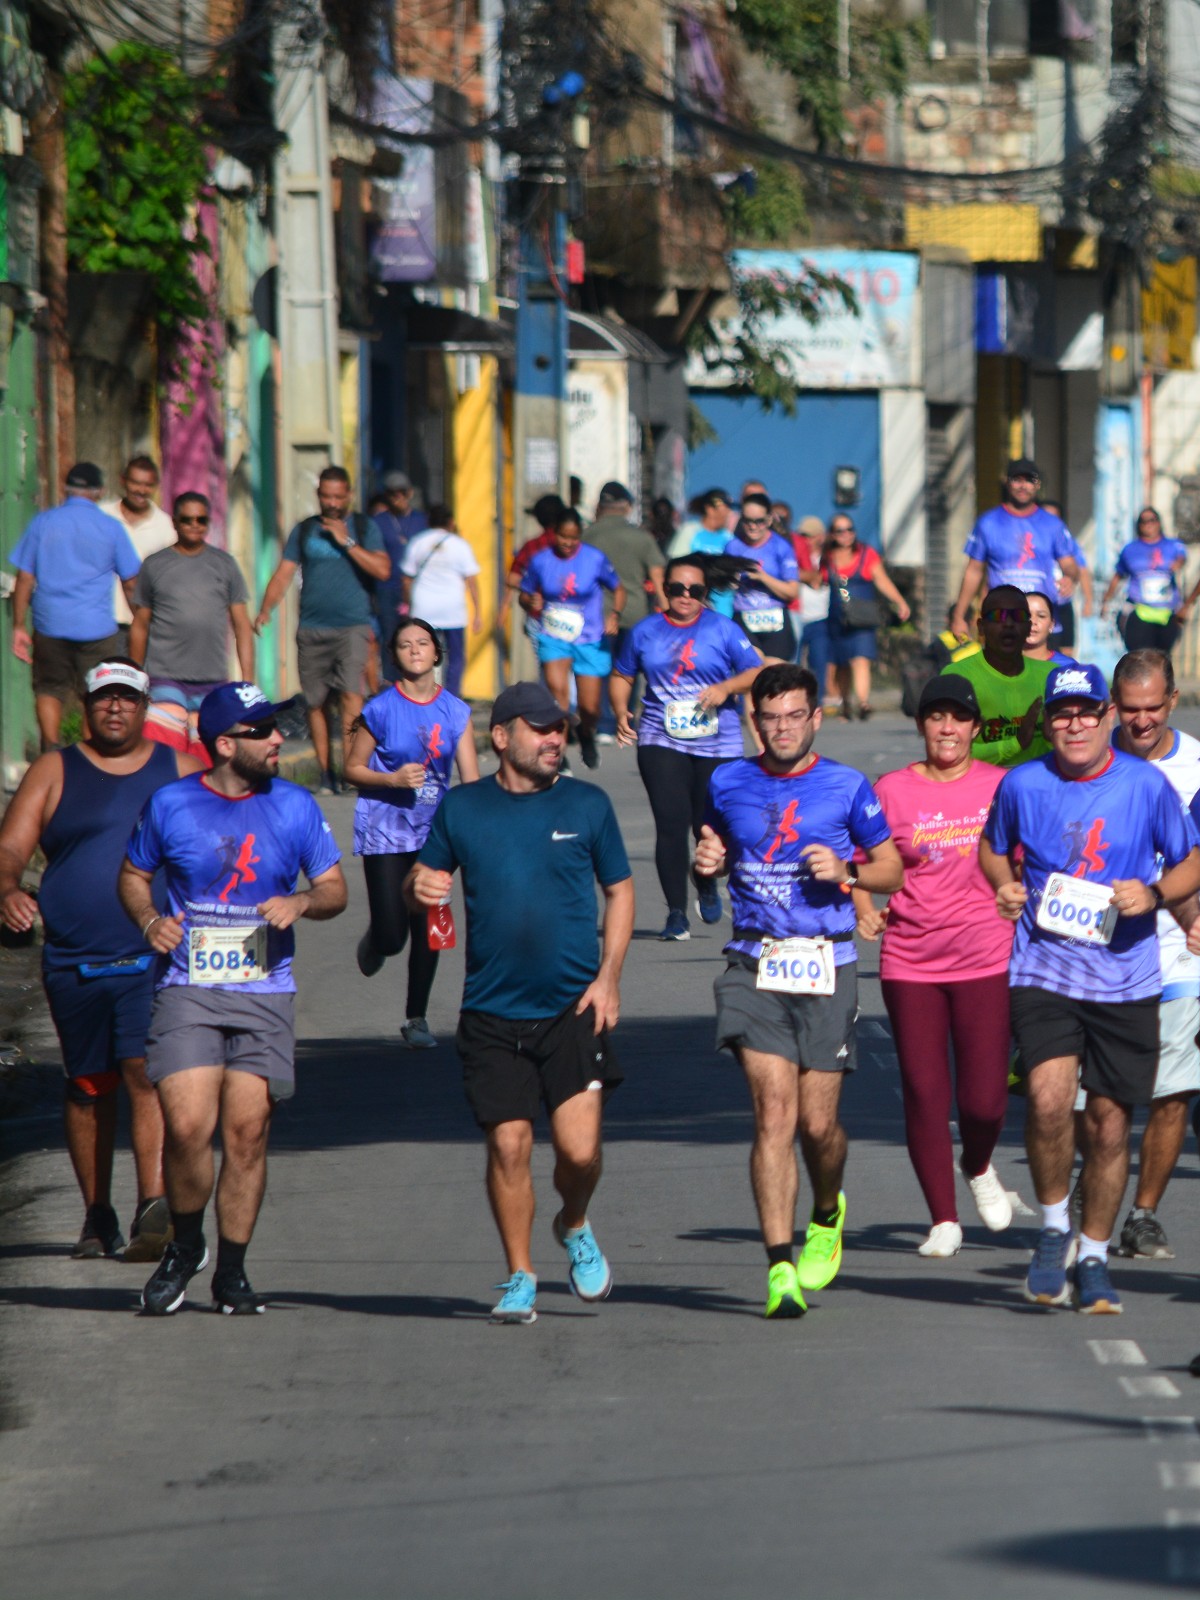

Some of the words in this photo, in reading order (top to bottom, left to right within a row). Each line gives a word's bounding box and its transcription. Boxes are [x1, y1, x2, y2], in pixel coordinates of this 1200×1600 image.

[912, 818, 963, 832] Mulheres
[962, 812, 988, 825] forte
[1048, 898, 1104, 929] 0001
[195, 950, 256, 970] 5084
[766, 959, 821, 979] 5100
